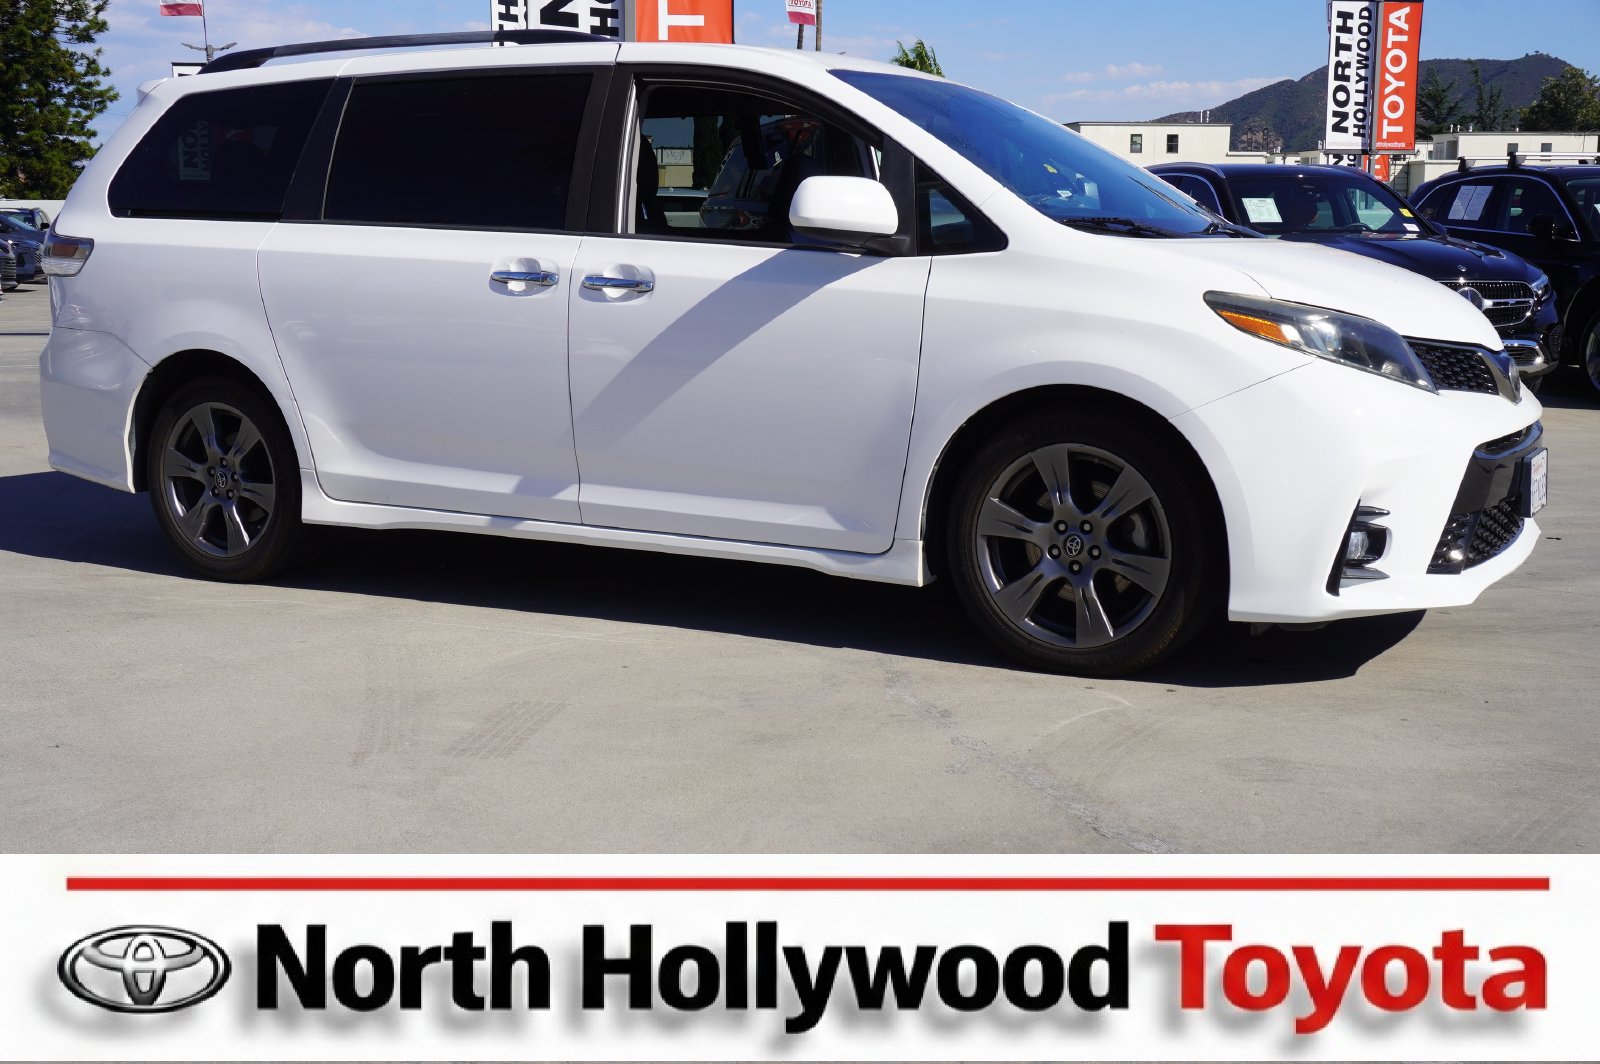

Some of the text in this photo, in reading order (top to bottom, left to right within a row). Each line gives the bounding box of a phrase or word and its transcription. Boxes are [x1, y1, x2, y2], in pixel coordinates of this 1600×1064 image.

[1331, 10, 1355, 134] NORTH
[1353, 6, 1373, 138] HOLLYWOOD
[1382, 6, 1411, 139] TOYOTA
